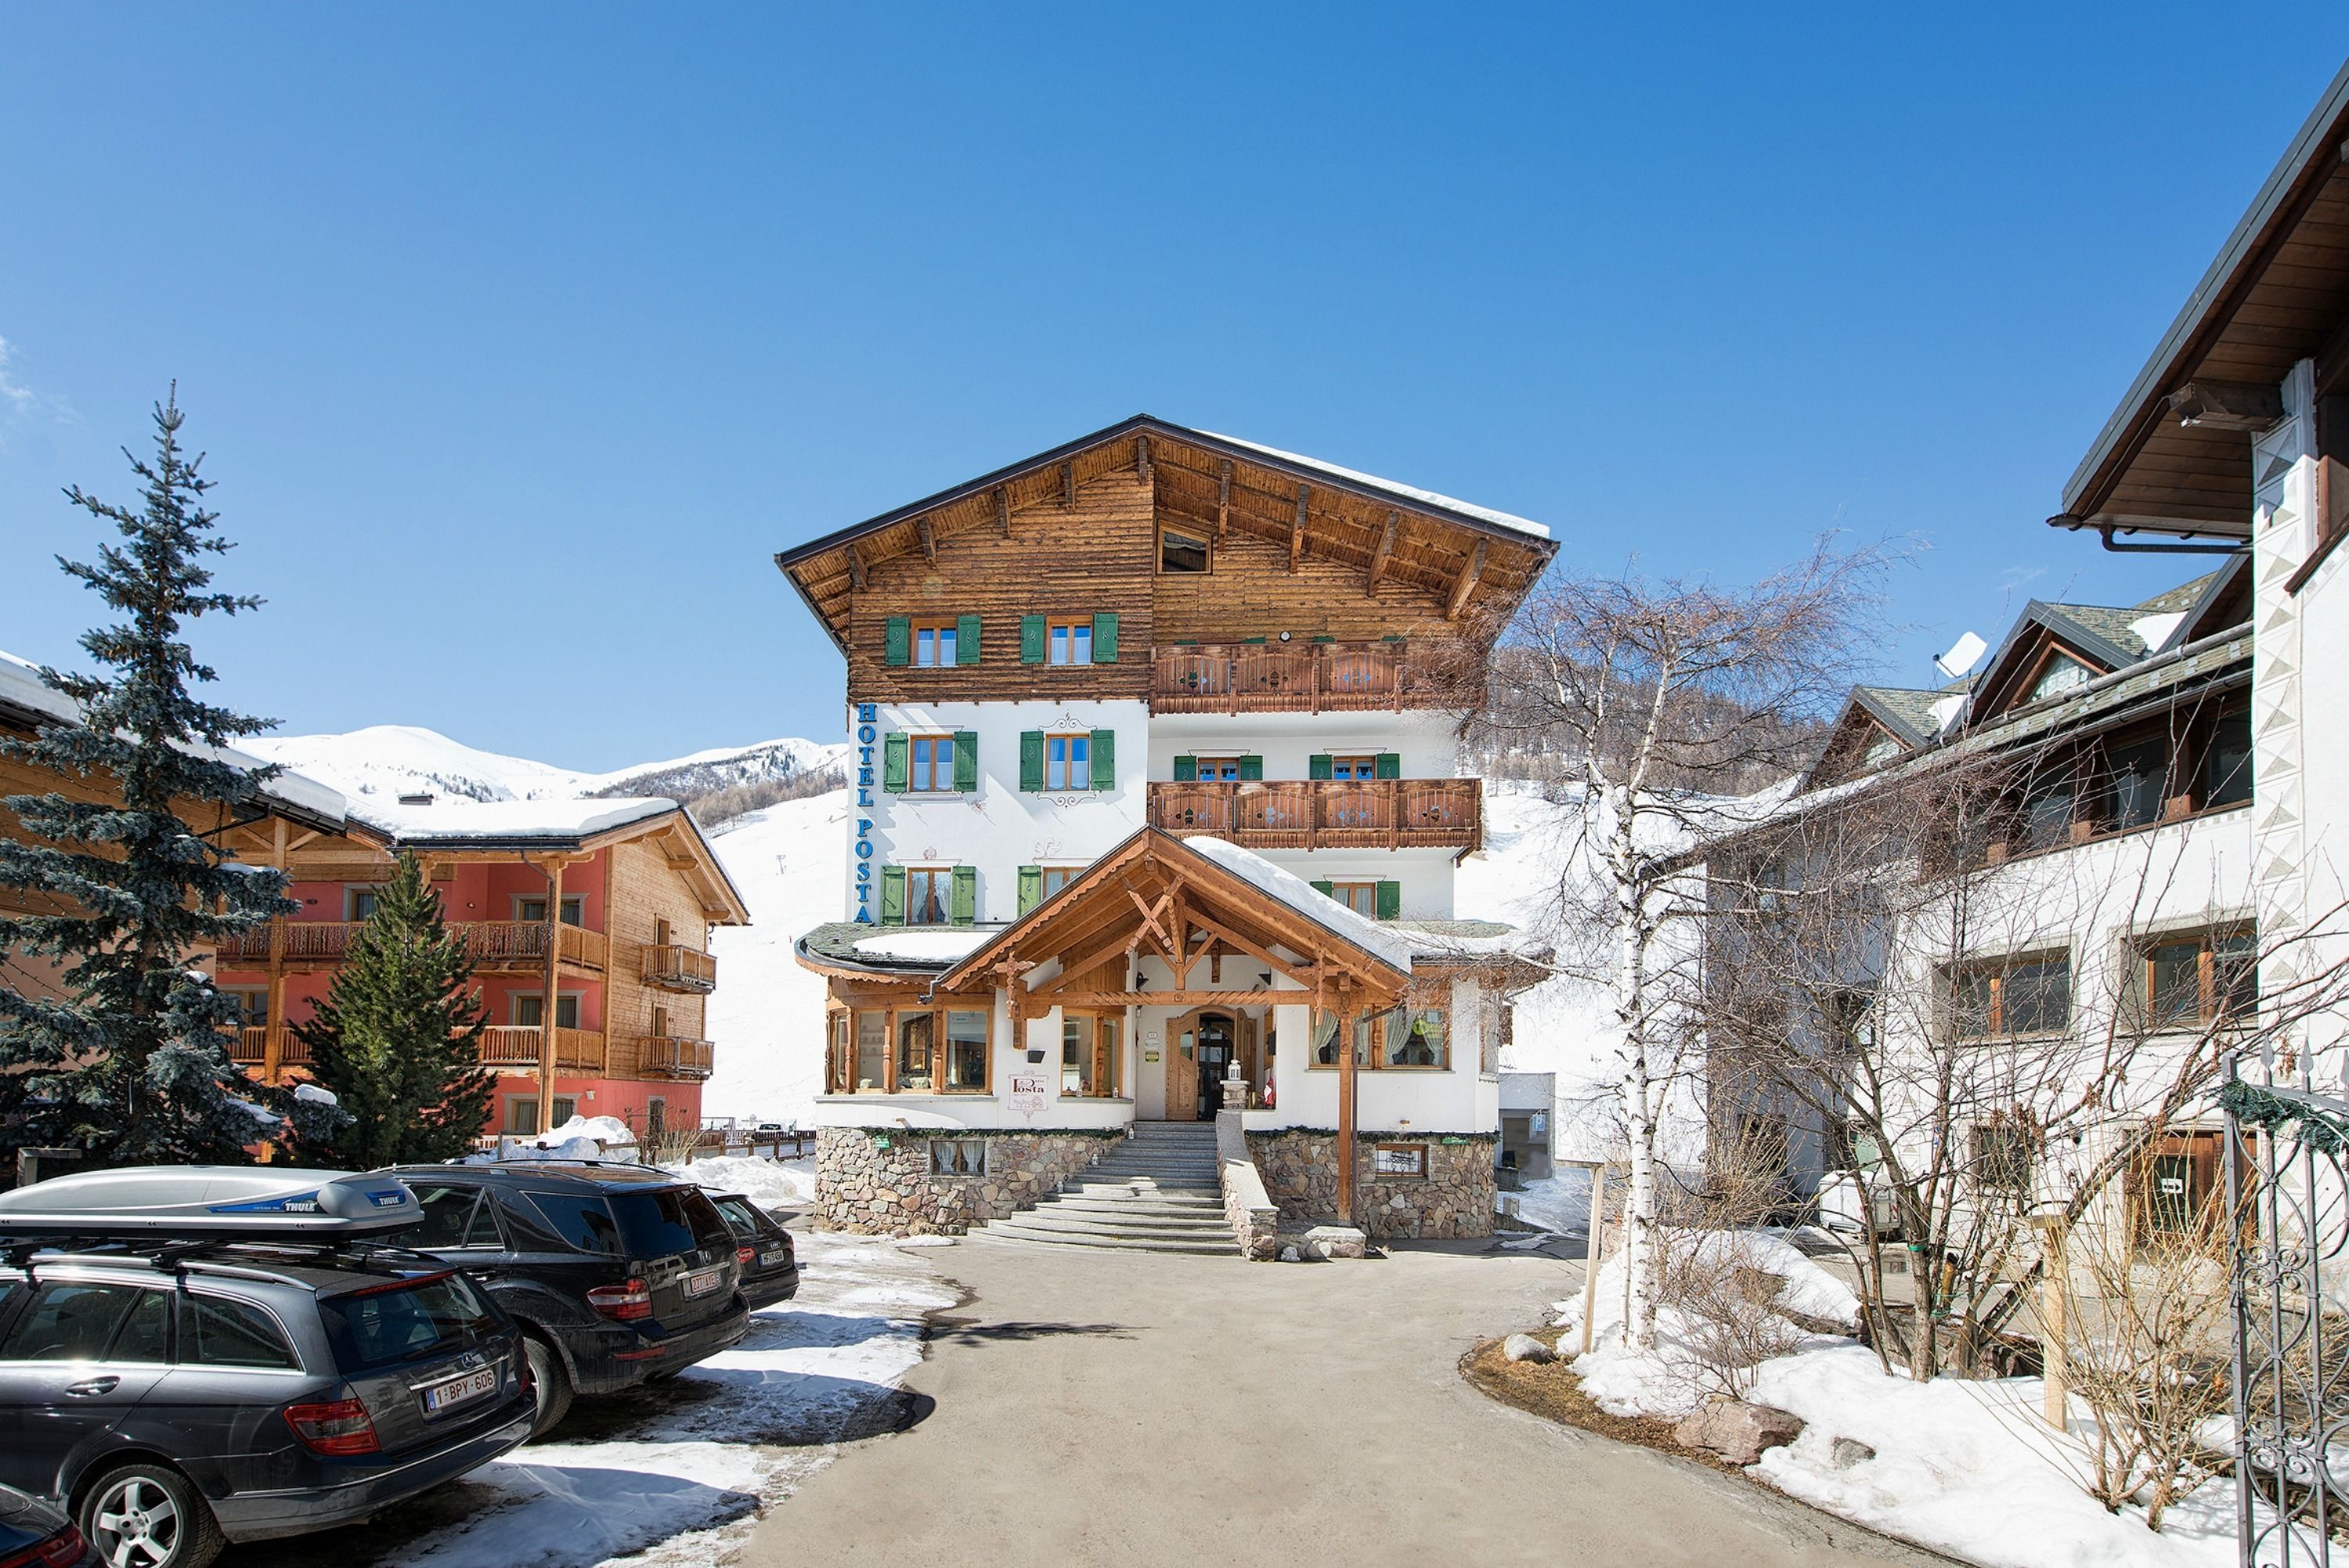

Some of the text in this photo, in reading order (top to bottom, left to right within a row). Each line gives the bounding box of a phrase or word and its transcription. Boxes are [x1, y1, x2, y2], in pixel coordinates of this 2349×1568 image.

[853, 704, 877, 924] HOTEL POSTA
[1012, 1079, 1045, 1093] Posta
[285, 1202, 316, 1212] THULE
[379, 1196, 399, 1206] THULE
